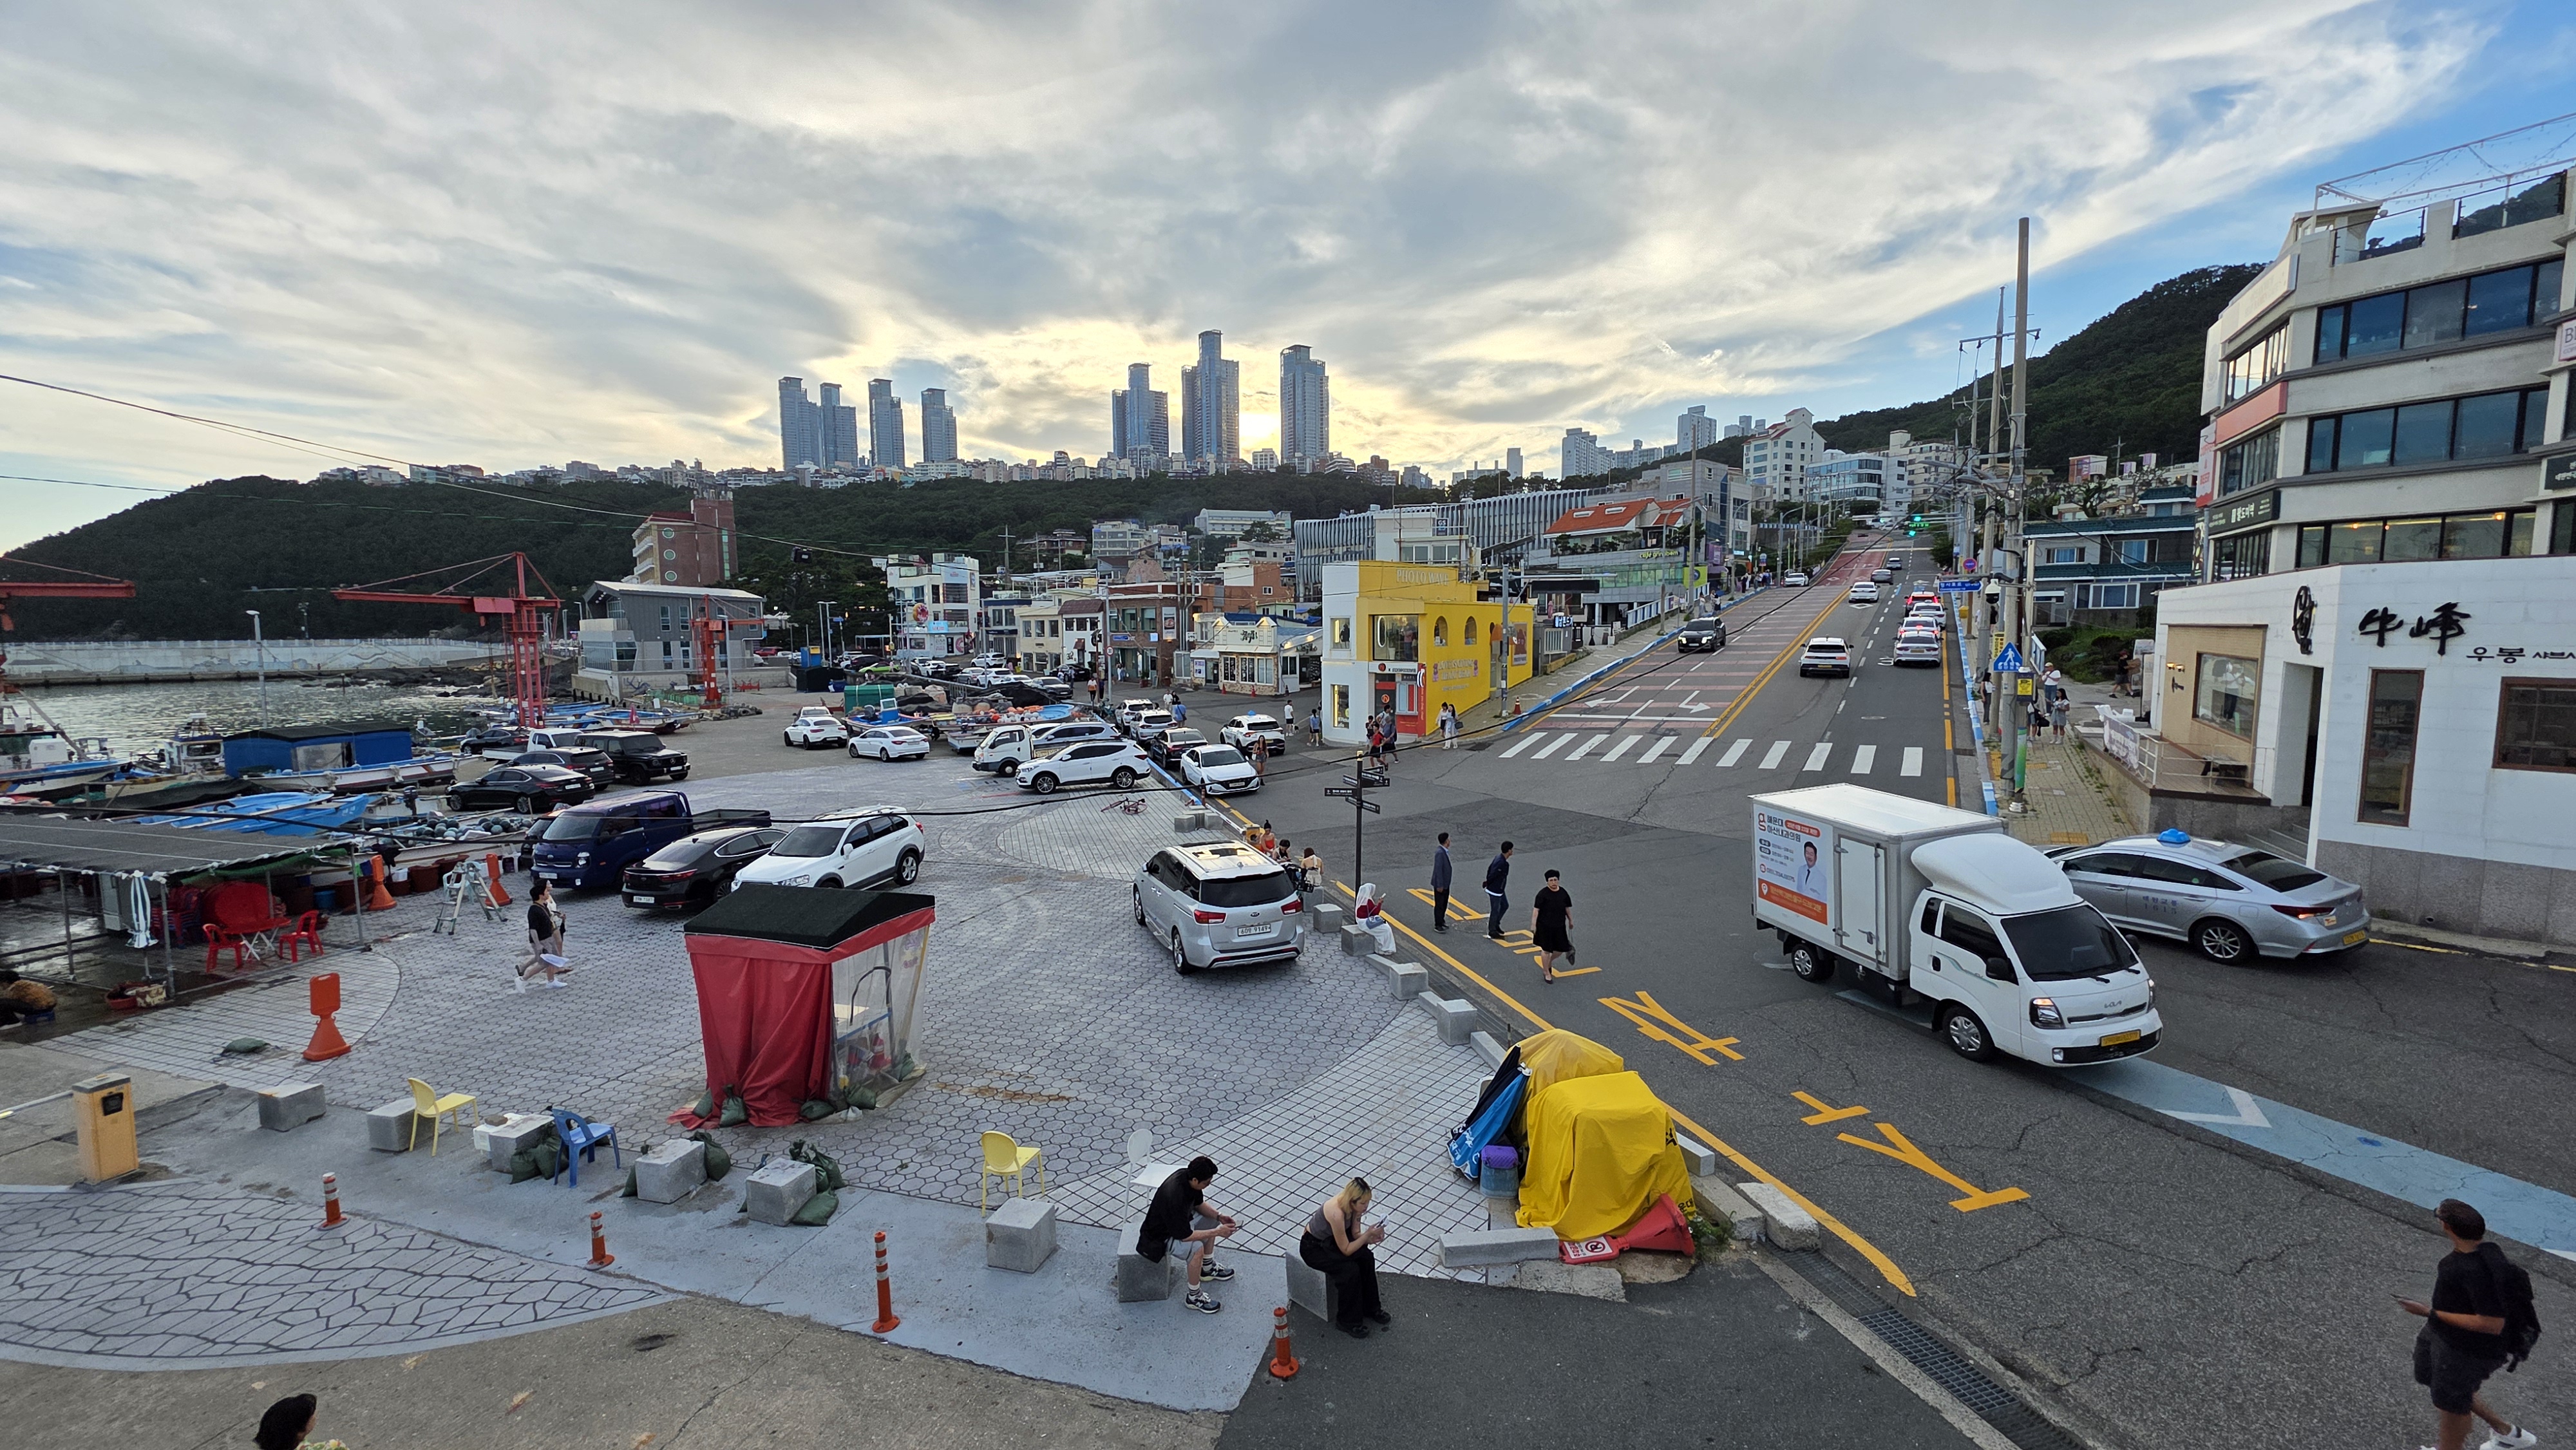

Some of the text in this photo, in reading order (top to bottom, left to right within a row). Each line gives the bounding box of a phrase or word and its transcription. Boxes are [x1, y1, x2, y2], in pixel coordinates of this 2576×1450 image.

[1396, 569, 1426, 584] PHOTO
[2466, 646, 2526, 664] 우봉
[1766, 814, 1783, 827] 해운대
[1767, 825, 1801, 842] 아산내과의원
